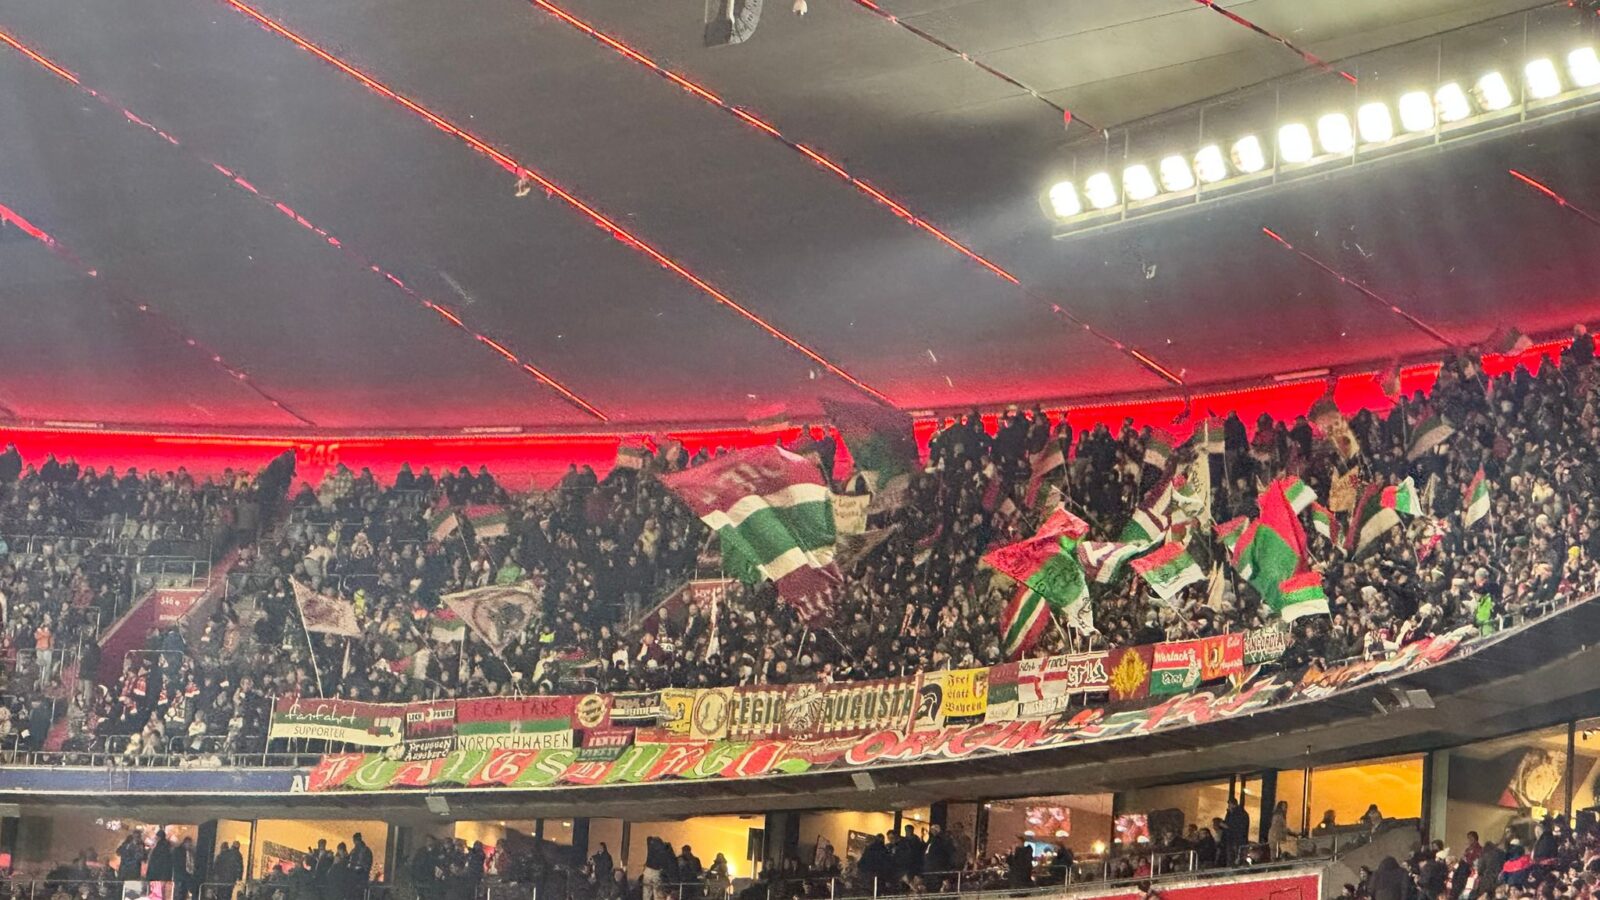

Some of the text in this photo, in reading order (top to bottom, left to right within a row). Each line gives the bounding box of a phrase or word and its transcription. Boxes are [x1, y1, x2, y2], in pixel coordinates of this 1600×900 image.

[300, 443, 340, 466] 346
[293, 725, 345, 739] SUPPORTER
[459, 732, 570, 752] NORDSCHWABEN
